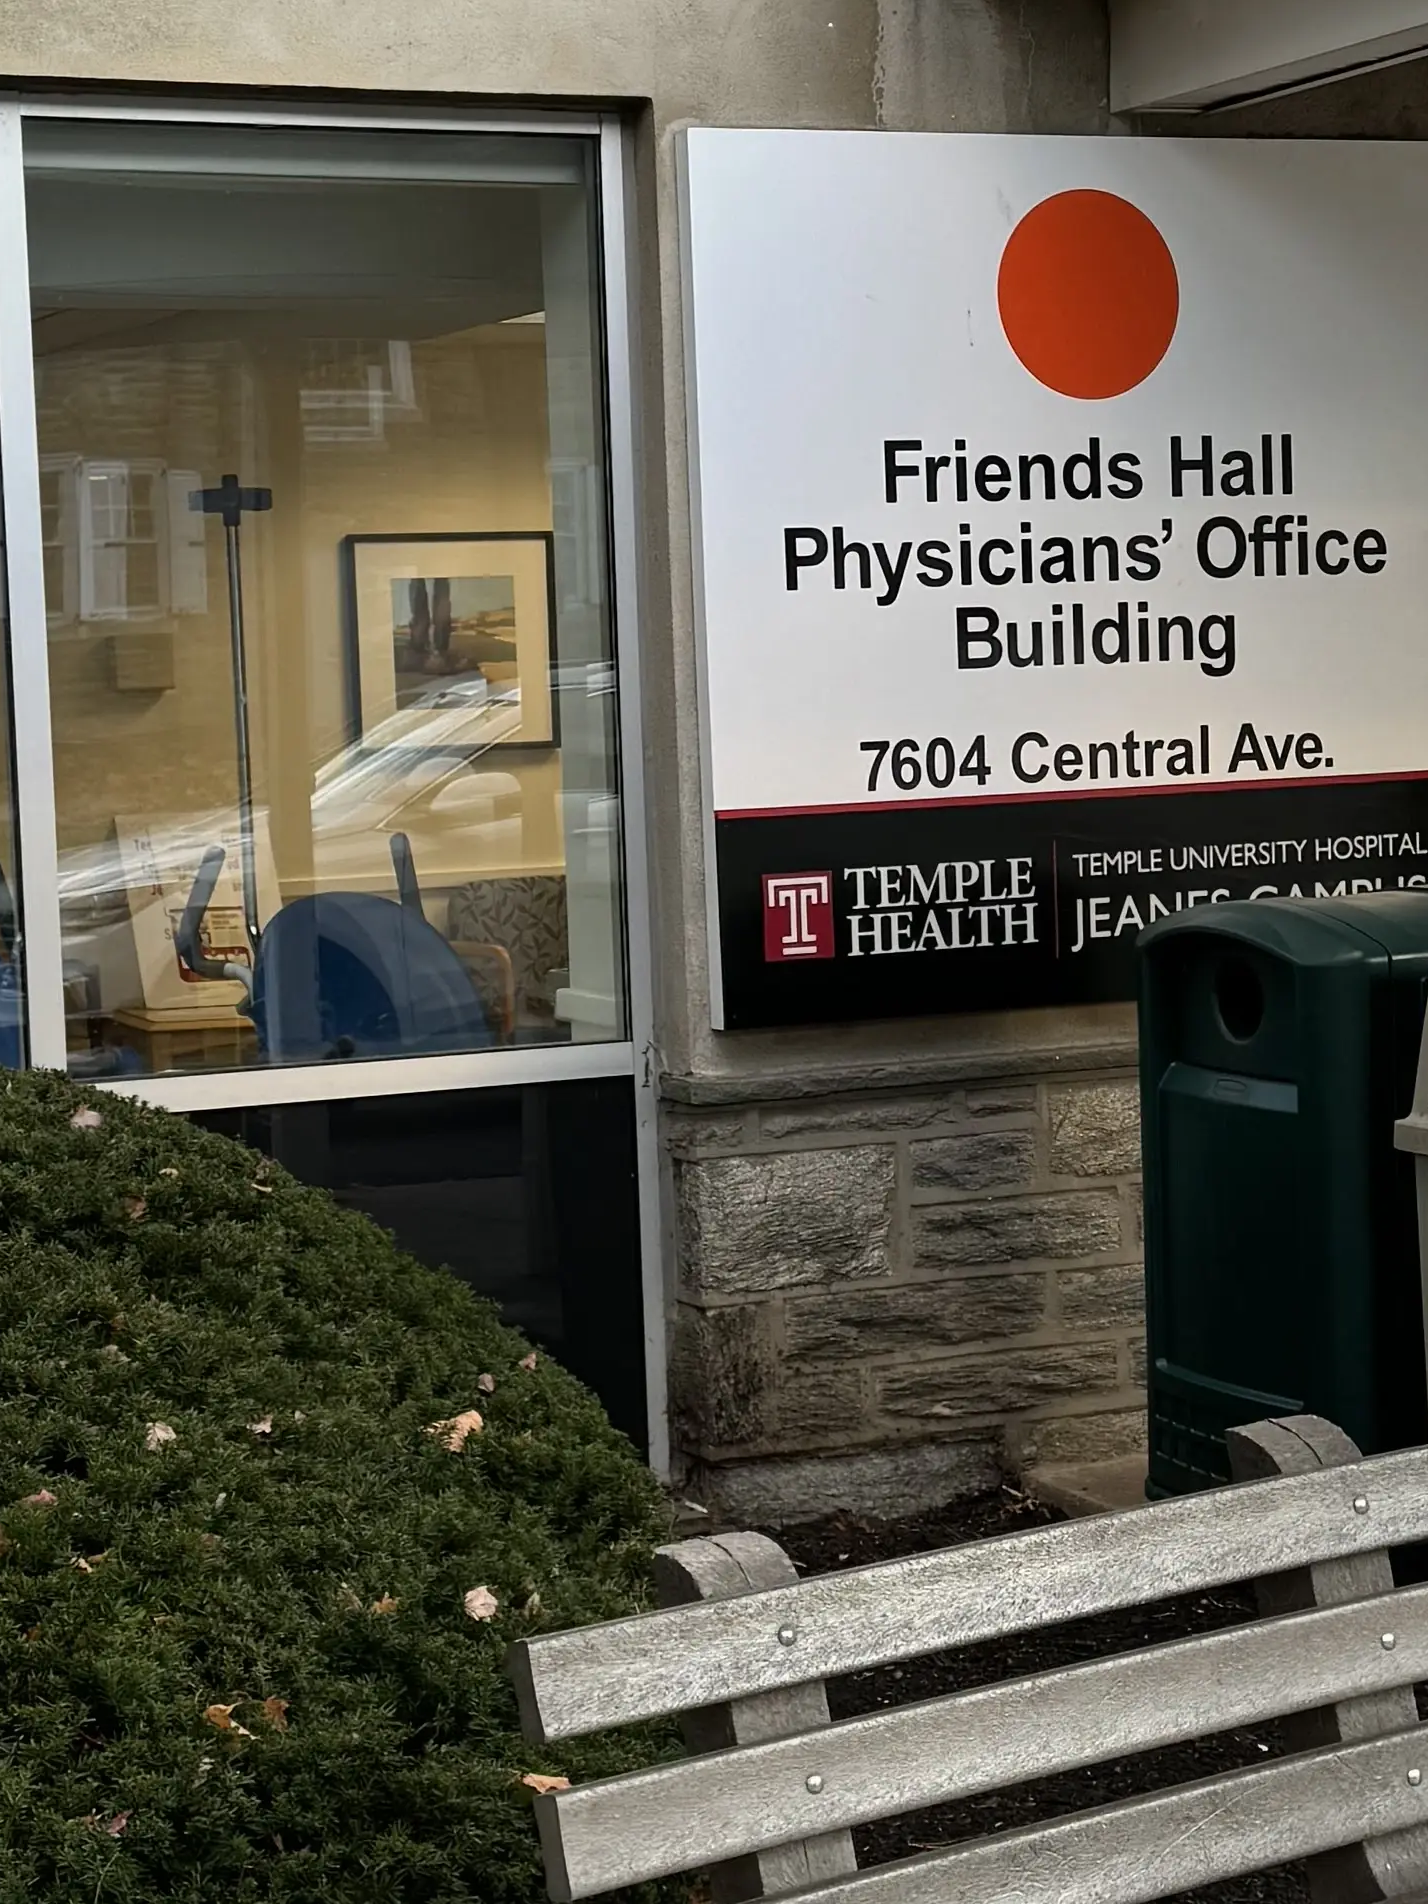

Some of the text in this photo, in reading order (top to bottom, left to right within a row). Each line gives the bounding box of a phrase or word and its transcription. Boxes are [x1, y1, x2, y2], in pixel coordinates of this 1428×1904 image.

[883, 433, 1294, 503] Friends Hall
[782, 514, 1389, 607] Physicians’ Office
[955, 601, 1237, 677] Building
[859, 723, 1335, 792] 7604 Central Ave.
[843, 857, 1036, 910] TEMPLE
[1071, 831, 1428, 878] TEMPLE UNIVERSITY HOSPITAL
[845, 902, 1040, 957] HEALTH
